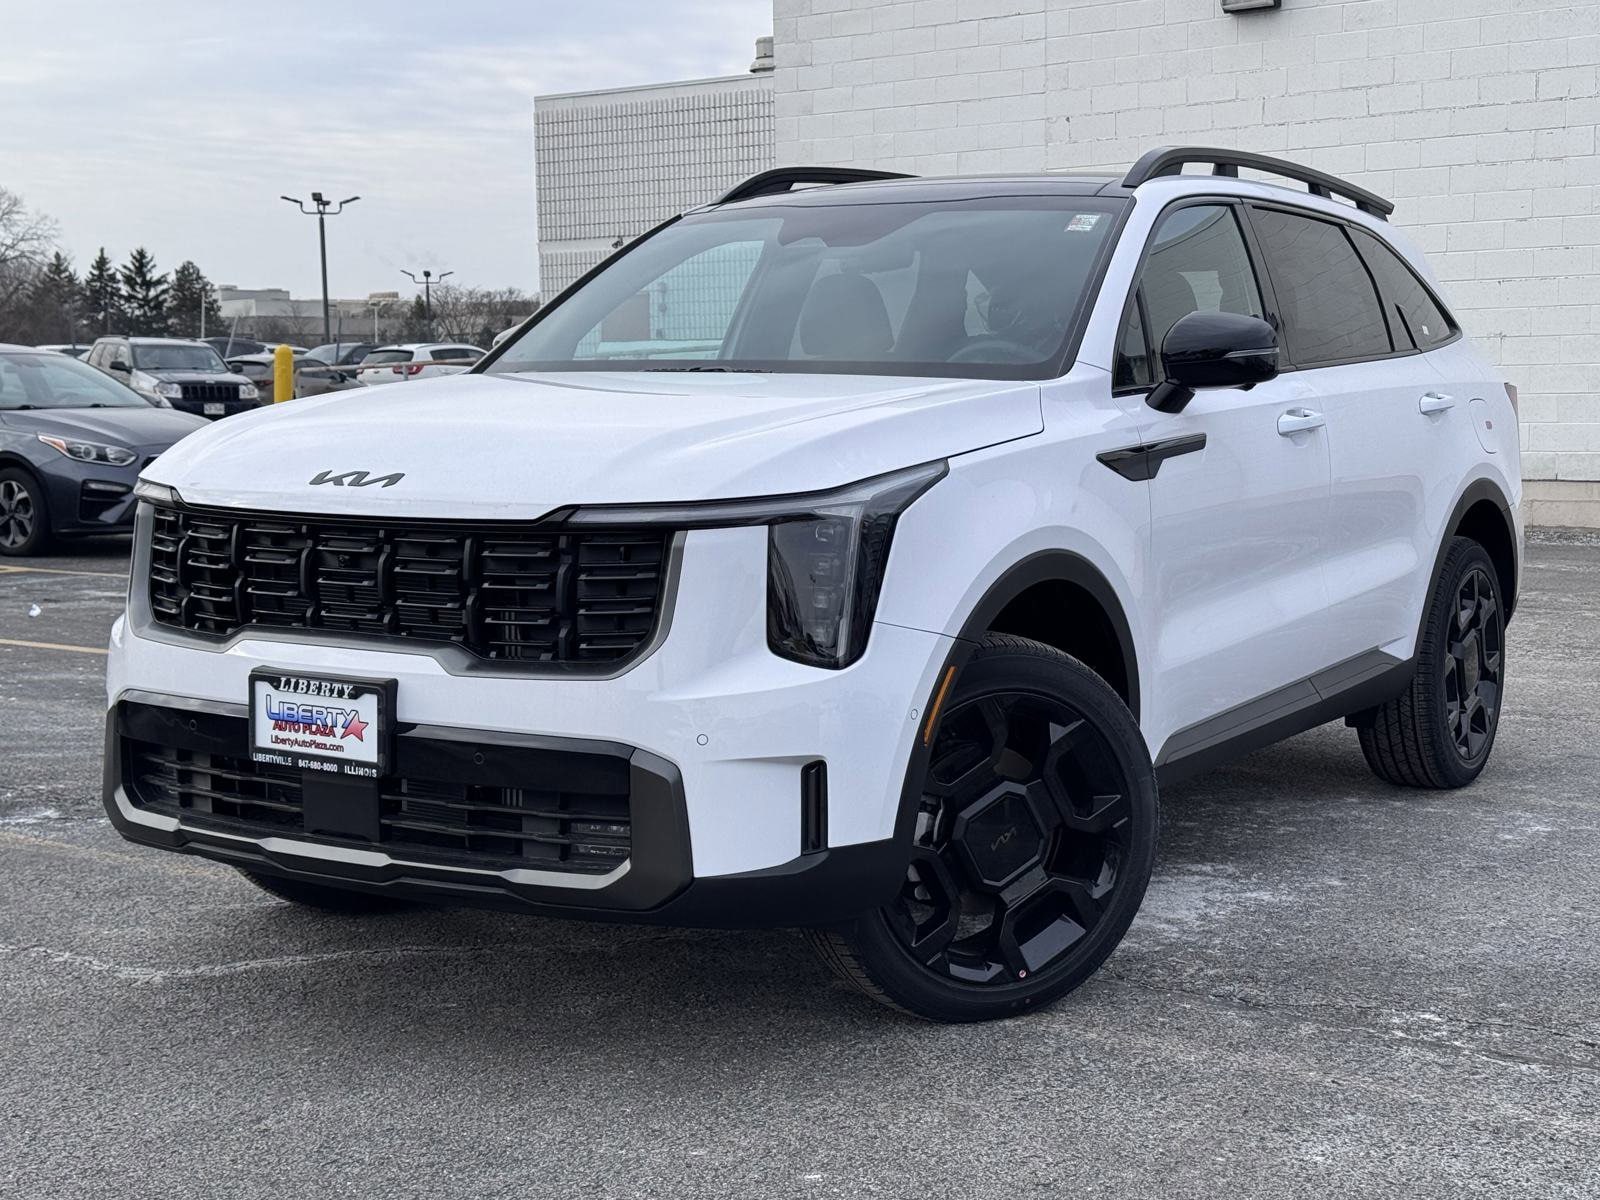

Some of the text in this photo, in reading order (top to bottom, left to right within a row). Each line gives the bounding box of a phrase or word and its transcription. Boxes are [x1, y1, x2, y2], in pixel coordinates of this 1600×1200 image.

[309, 469, 406, 488] KIA
[279, 677, 353, 699] LIBERTY
[265, 694, 358, 729] LIBERTY
[272, 720, 337, 738] AUTO PLAZA
[271, 735, 344, 752] LibertyAutoPlaza.com
[252, 753, 292, 766] LIBERTYVILLE
[344, 765, 377, 778] ILLINOIS
